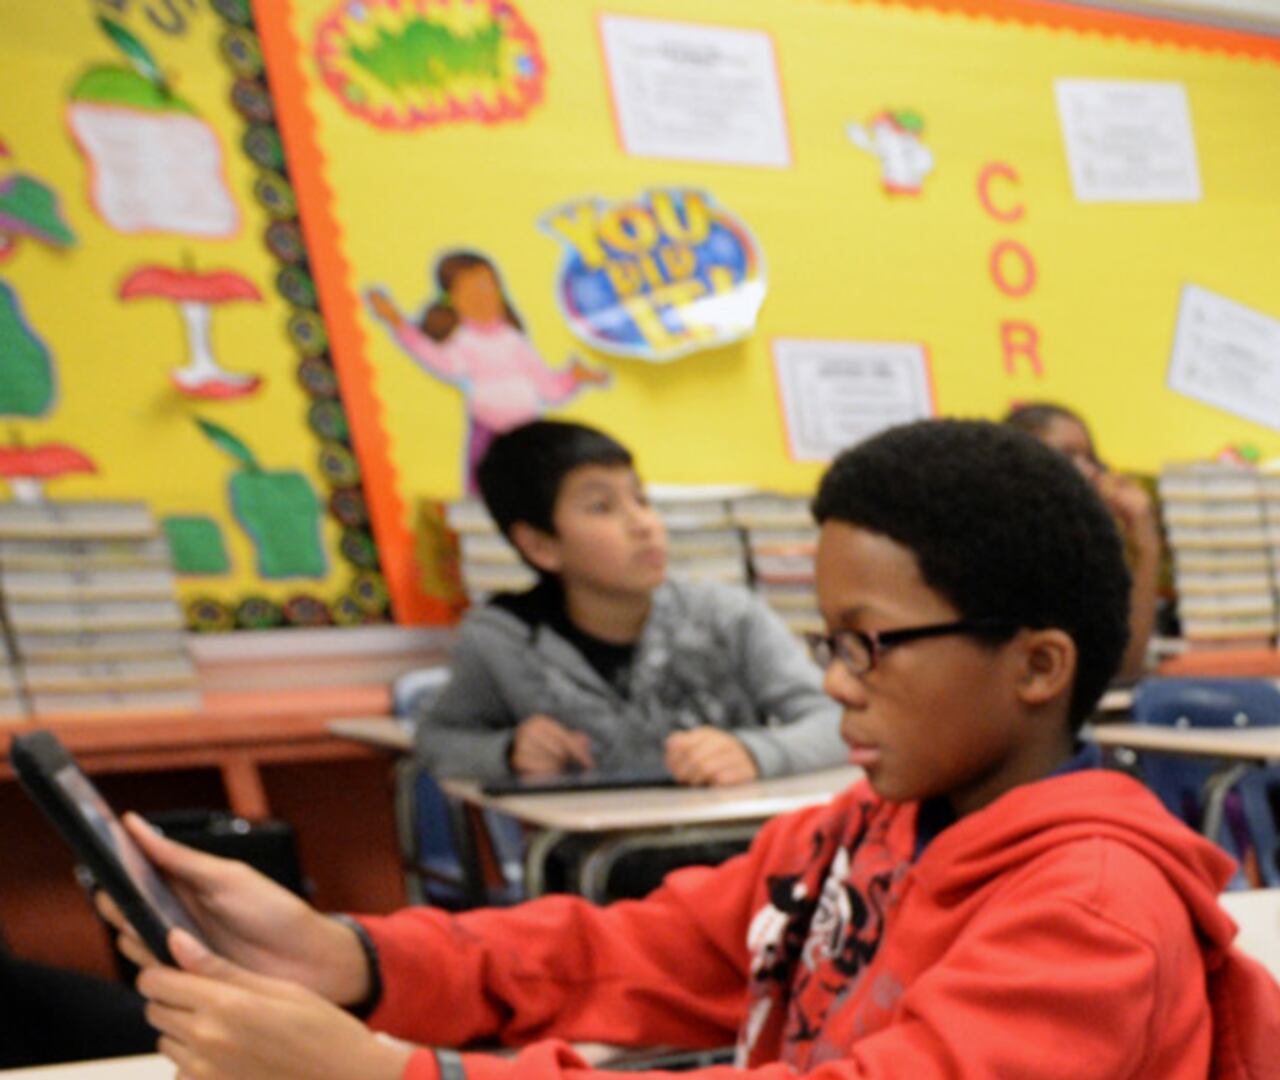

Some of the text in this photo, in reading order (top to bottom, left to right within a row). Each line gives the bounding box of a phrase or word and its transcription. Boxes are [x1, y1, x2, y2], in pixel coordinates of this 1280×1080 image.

[552, 192, 708, 267] YOU
[606, 248, 697, 297] DID
[976, 160, 1047, 408] COR
